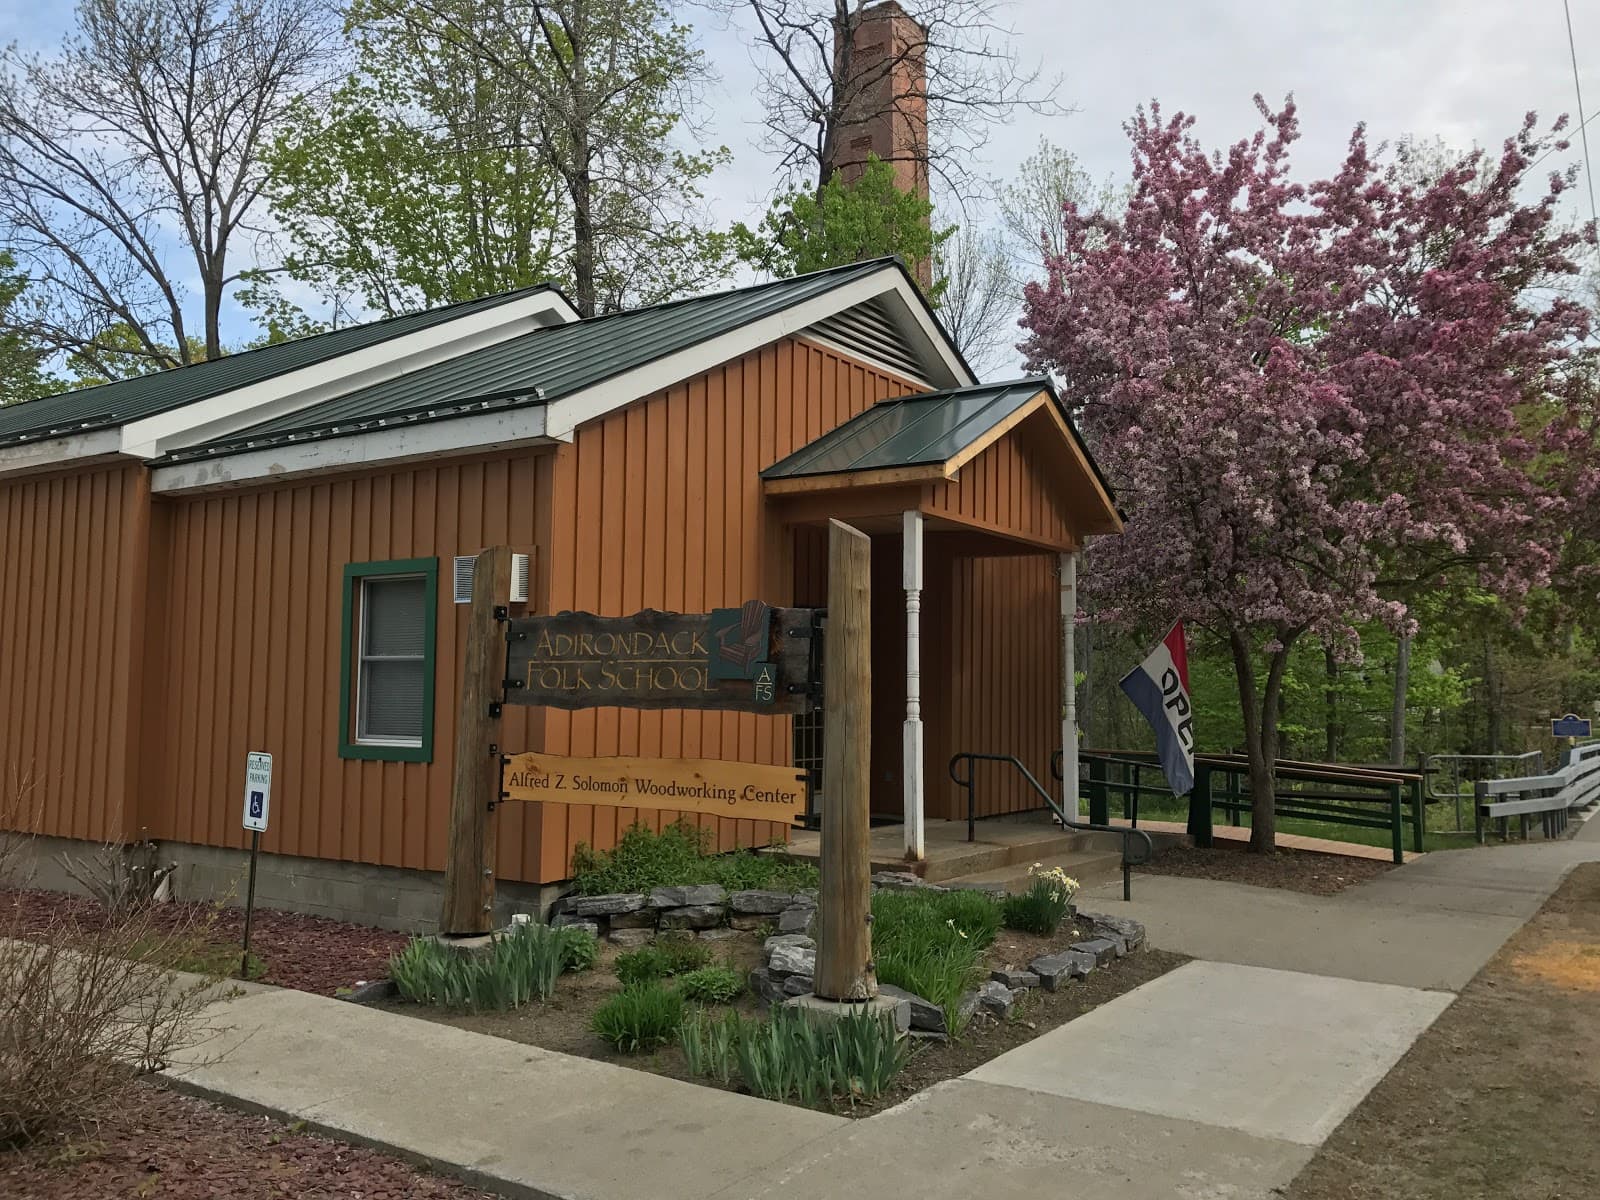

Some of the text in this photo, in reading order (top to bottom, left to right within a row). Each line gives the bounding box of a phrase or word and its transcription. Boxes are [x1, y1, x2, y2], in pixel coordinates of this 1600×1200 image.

[534, 629, 709, 656] ADIRONDACK
[526, 661, 719, 691] FOLK SCHOOL
[758, 667, 771, 682] A
[756, 685, 772, 700] FS
[1162, 668, 1194, 755] OPE
[509, 773, 549, 789] Alfred
[573, 776, 628, 793] Solomon
[635, 779, 737, 804] Woodworking
[743, 785, 797, 804] Center
